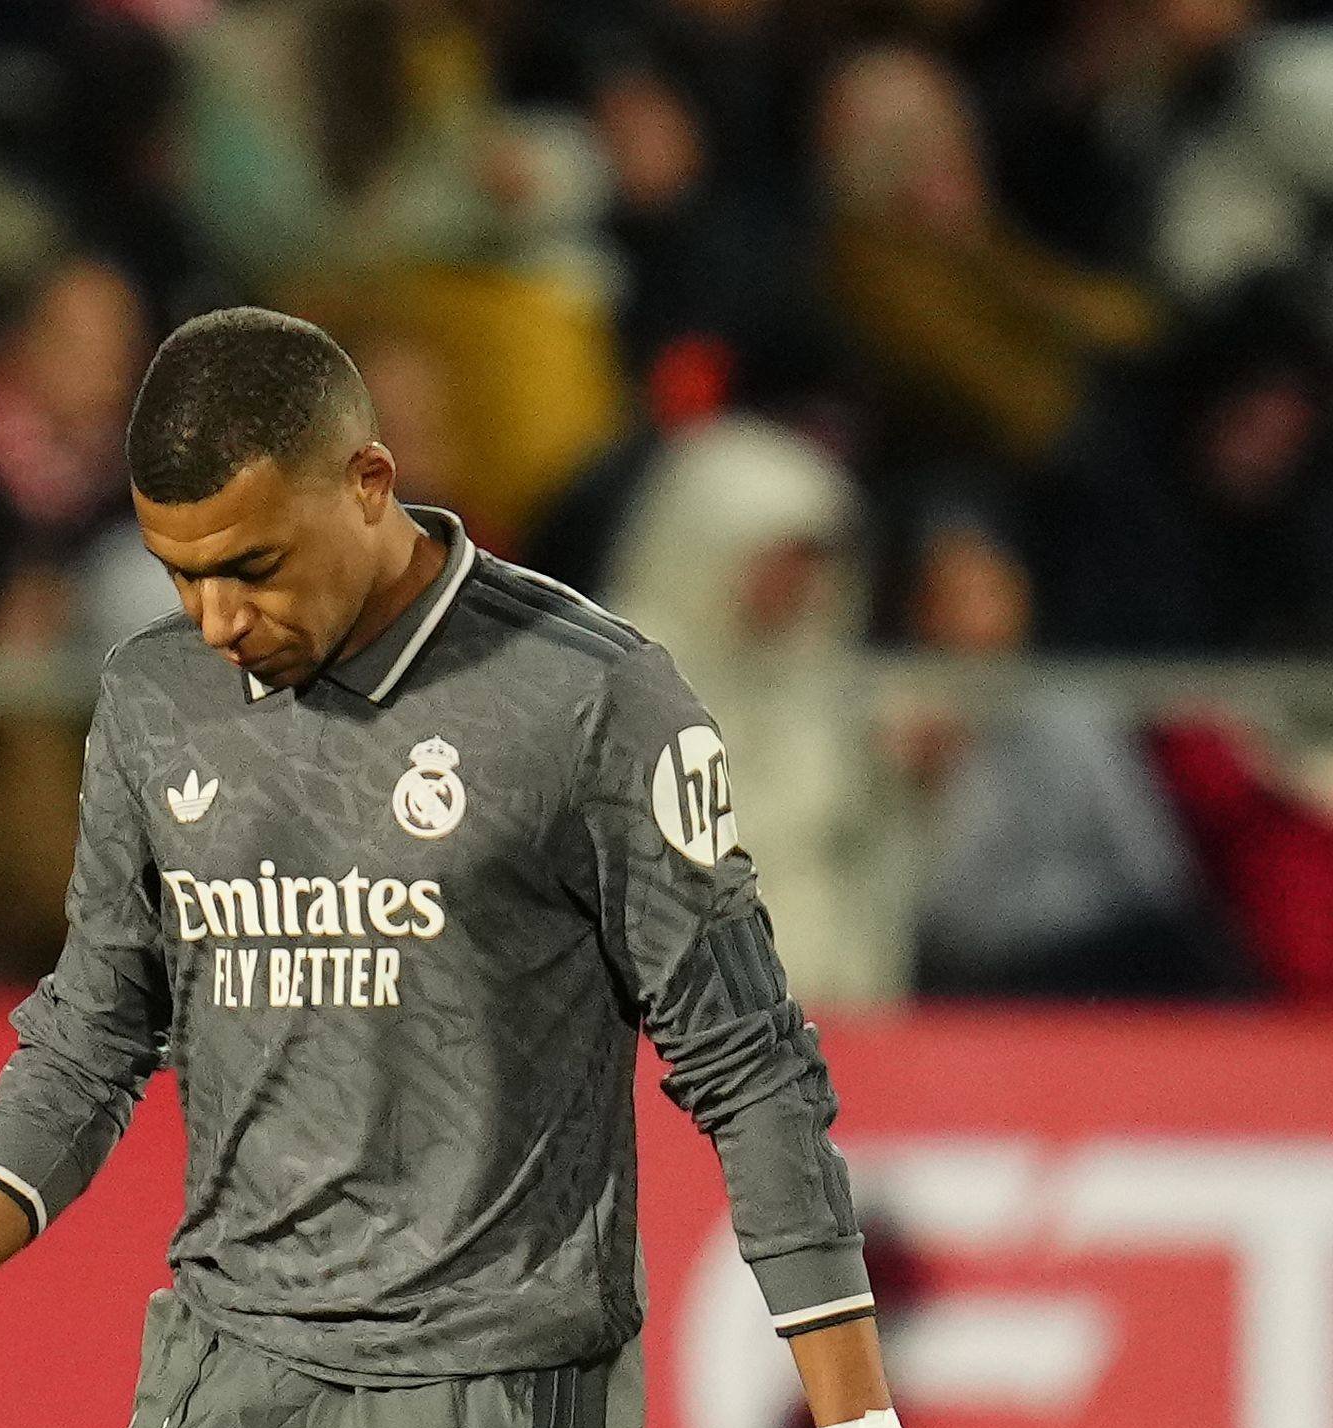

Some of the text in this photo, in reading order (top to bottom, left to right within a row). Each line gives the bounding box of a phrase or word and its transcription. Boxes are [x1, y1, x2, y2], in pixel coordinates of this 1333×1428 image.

[668, 734, 733, 868] hp
[161, 859, 446, 942] Emirates
[212, 946, 401, 1009] FLY BETTER
